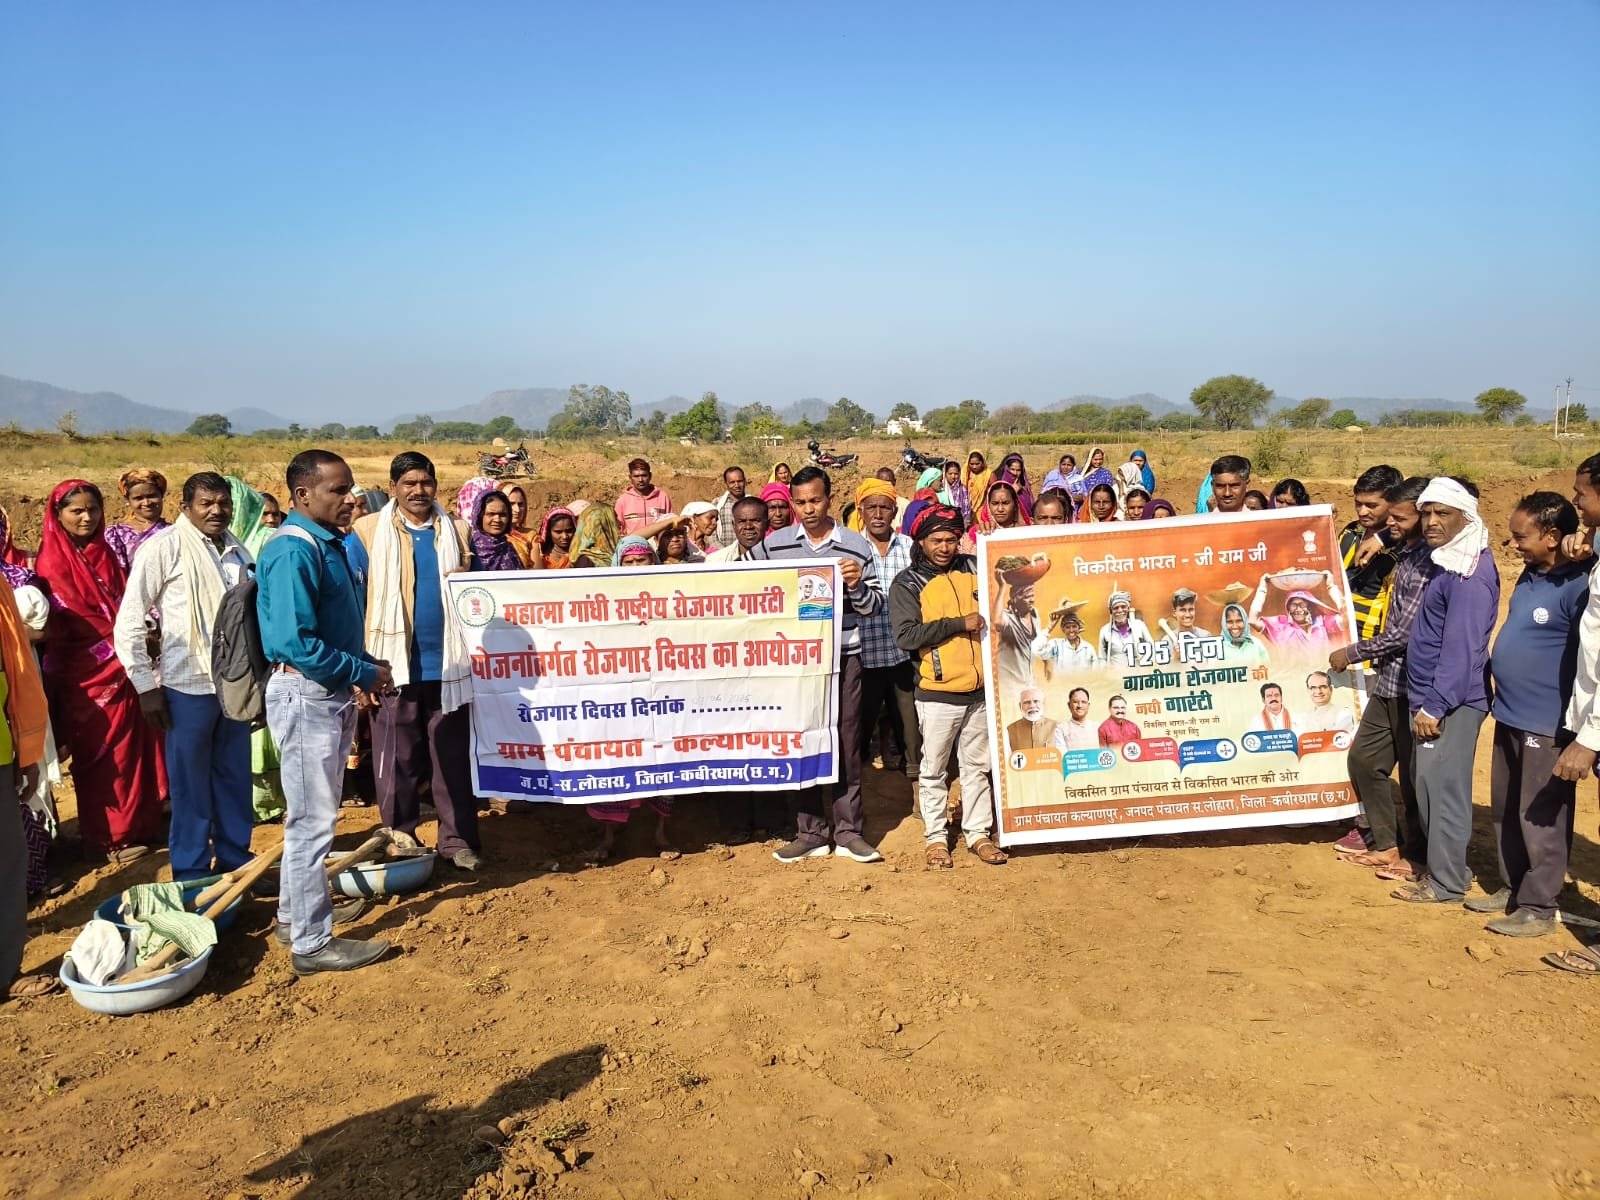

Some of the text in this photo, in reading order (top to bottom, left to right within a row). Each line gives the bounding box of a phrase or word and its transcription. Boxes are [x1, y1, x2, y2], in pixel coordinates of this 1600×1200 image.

[1073, 555, 1134, 577] विकसित
[1138, 553, 1176, 571] भारत
[1194, 546, 1213, 566] जी
[1218, 549, 1244, 564] राम
[1248, 541, 1267, 562] जी
[503, 586, 785, 625] महात्मा गांधी राष्ट्रीय रोजगार गारंटी
[470, 632, 823, 680] योजनांतर्गत रोजगार दिवस का आयोजन
[1122, 631, 1225, 667] 125 दिन
[1123, 665, 1269, 692] ग्रामीण रोजगार की
[517, 703, 577, 722] रोजगार
[582, 700, 627, 720] दिवस
[631, 695, 685, 718] दिनांक
[1164, 690, 1213, 713] गारंटी
[496, 742, 545, 761] ग्राम
[553, 737, 645, 761] पंचायत
[672, 731, 804, 756] कल्याणपुर
[1065, 770, 1300, 800] विकसित ग्राम पंचायत से विकसित भारत की ओर
[1014, 815, 1033, 827] ग्राम
[1035, 811, 1068, 825] पंचायत
[1125, 806, 1154, 818] जनपद
[1156, 802, 1190, 815] पंचायत
